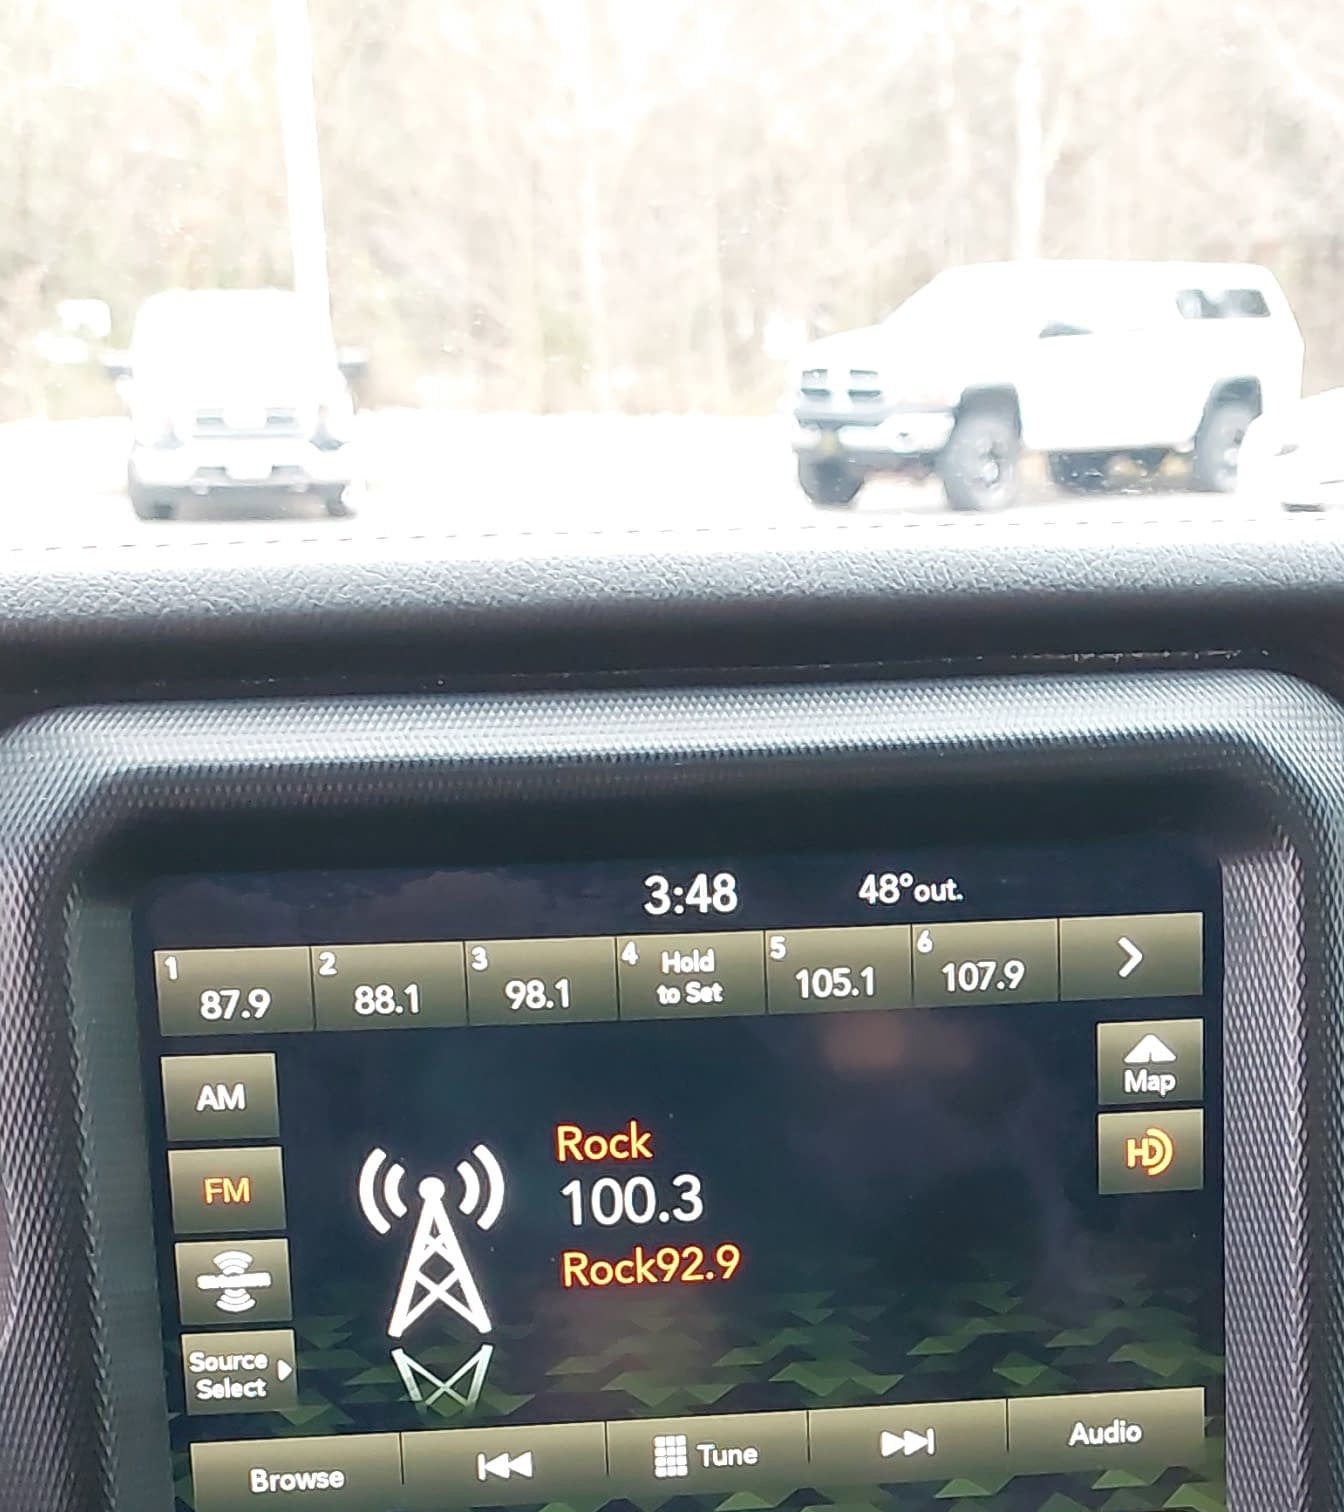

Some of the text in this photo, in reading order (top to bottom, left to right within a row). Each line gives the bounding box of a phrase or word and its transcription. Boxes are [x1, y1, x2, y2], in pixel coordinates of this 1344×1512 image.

[644, 873, 738, 915] 3:48
[621, 942, 638, 964] 4
[770, 936, 786, 959] 5
[917, 931, 933, 953] 6
[164, 957, 179, 980] 1
[319, 952, 338, 976] 2
[472, 948, 488, 970] 3
[661, 949, 715, 974] Hold
[795, 966, 875, 999] 105.1
[942, 960, 1025, 992] 107.9
[200, 989, 271, 1021] 87.9
[354, 984, 421, 1016] 88.1
[505, 979, 571, 1010] 98.1
[657, 982, 723, 1004] to Set
[1124, 1070, 1176, 1096] Map
[196, 1084, 245, 1111] AM
[556, 1120, 653, 1163] Rock
[204, 1177, 251, 1205] FM
[560, 1174, 704, 1227] 100.3
[563, 1244, 740, 1286] Rock92.9
[189, 1352, 268, 1373] Source
[197, 1377, 267, 1400] Select
[1068, 1420, 1142, 1448] Audio
[697, 1442, 758, 1468] Tune
[250, 1468, 345, 1493] Browse
